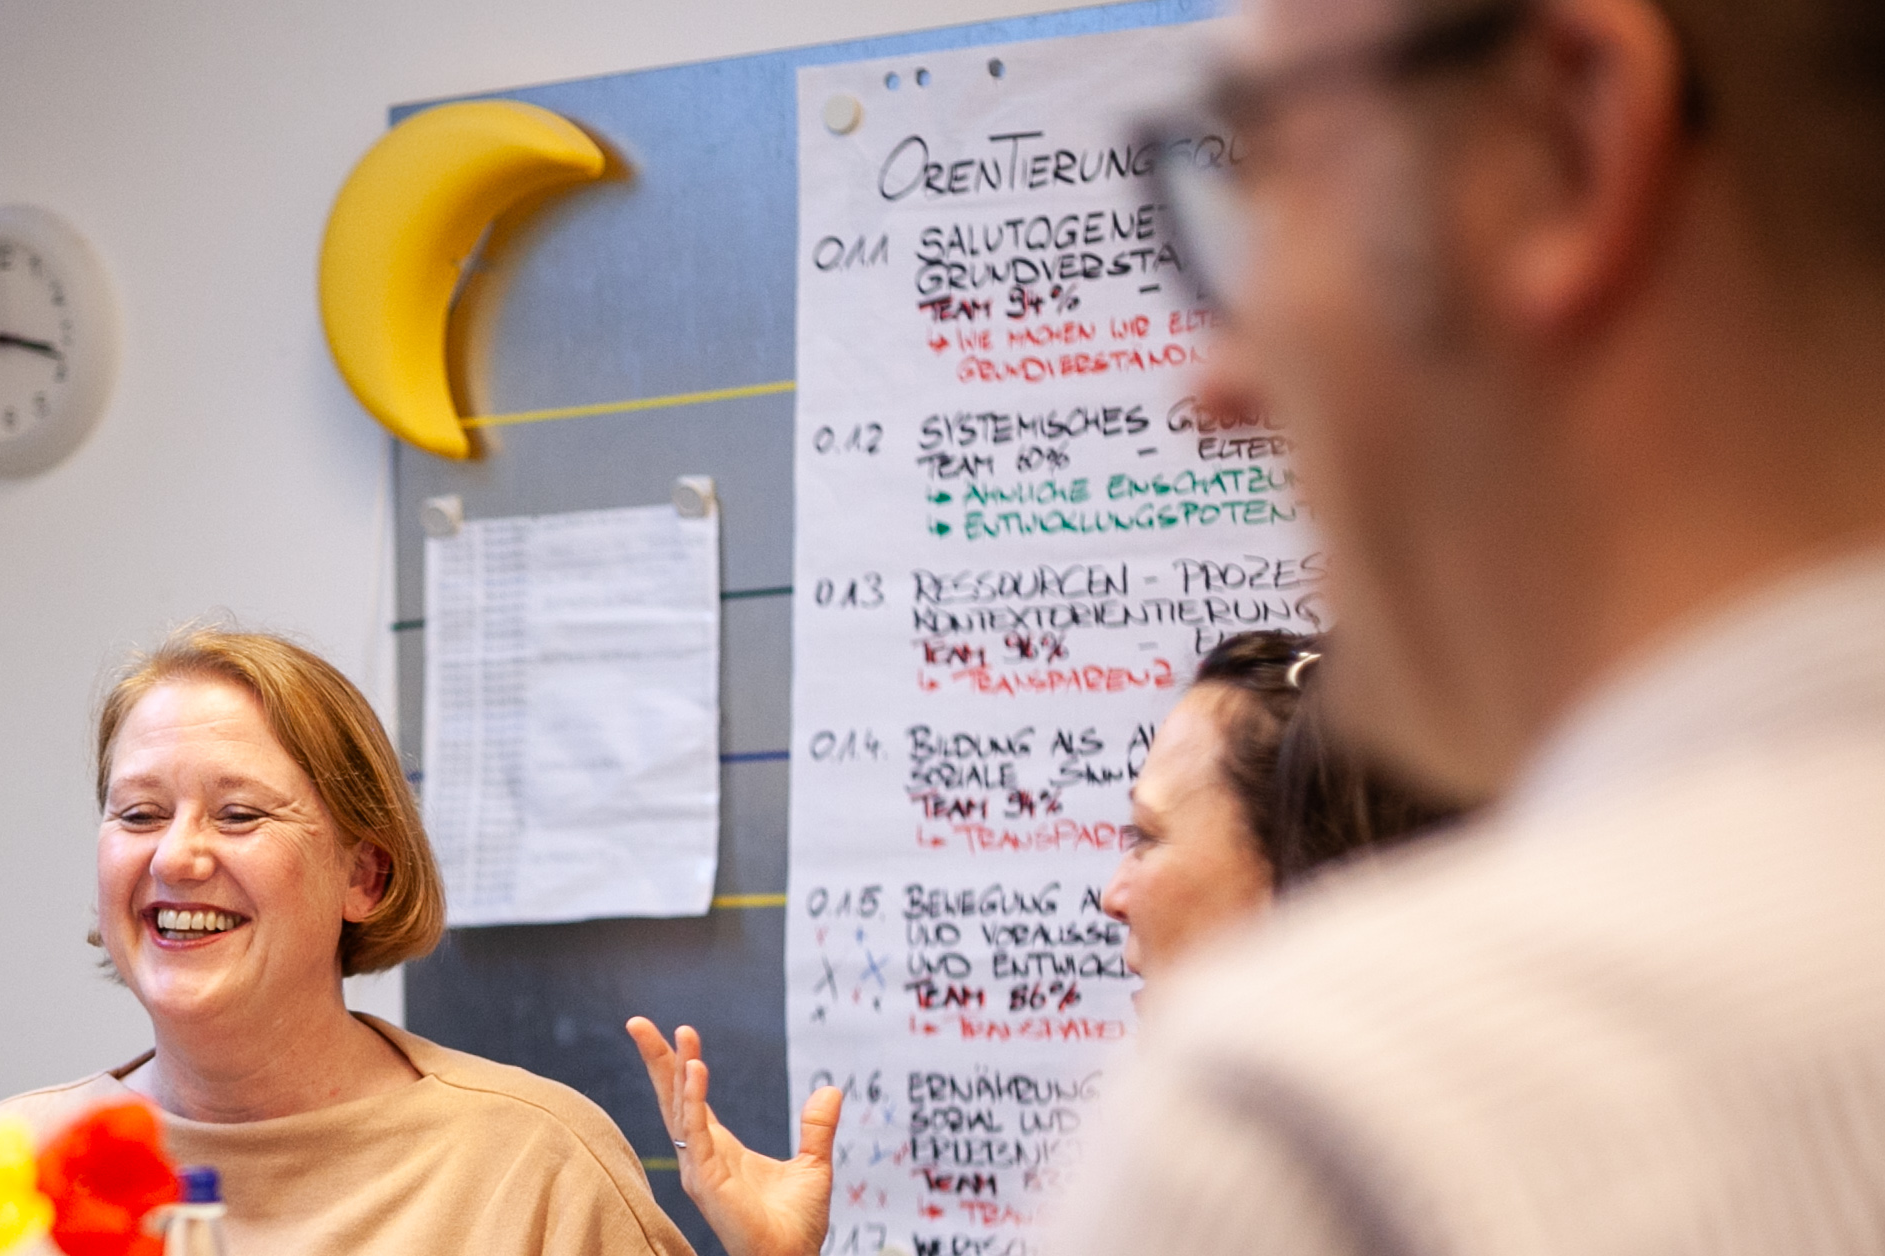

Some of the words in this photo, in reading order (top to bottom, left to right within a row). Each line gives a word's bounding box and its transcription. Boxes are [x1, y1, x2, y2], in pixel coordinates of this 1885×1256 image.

[916, 204, 1170, 265] SALUTOGENE
[918, 297, 992, 322] TEAM
[916, 451, 995, 479] TEAM
[912, 562, 1128, 604] RESSOURCEN
[913, 636, 991, 669] TEAM
[910, 789, 988, 819] TEAM
[905, 980, 985, 1011] TEAM
[912, 1164, 999, 1197] TEAM
